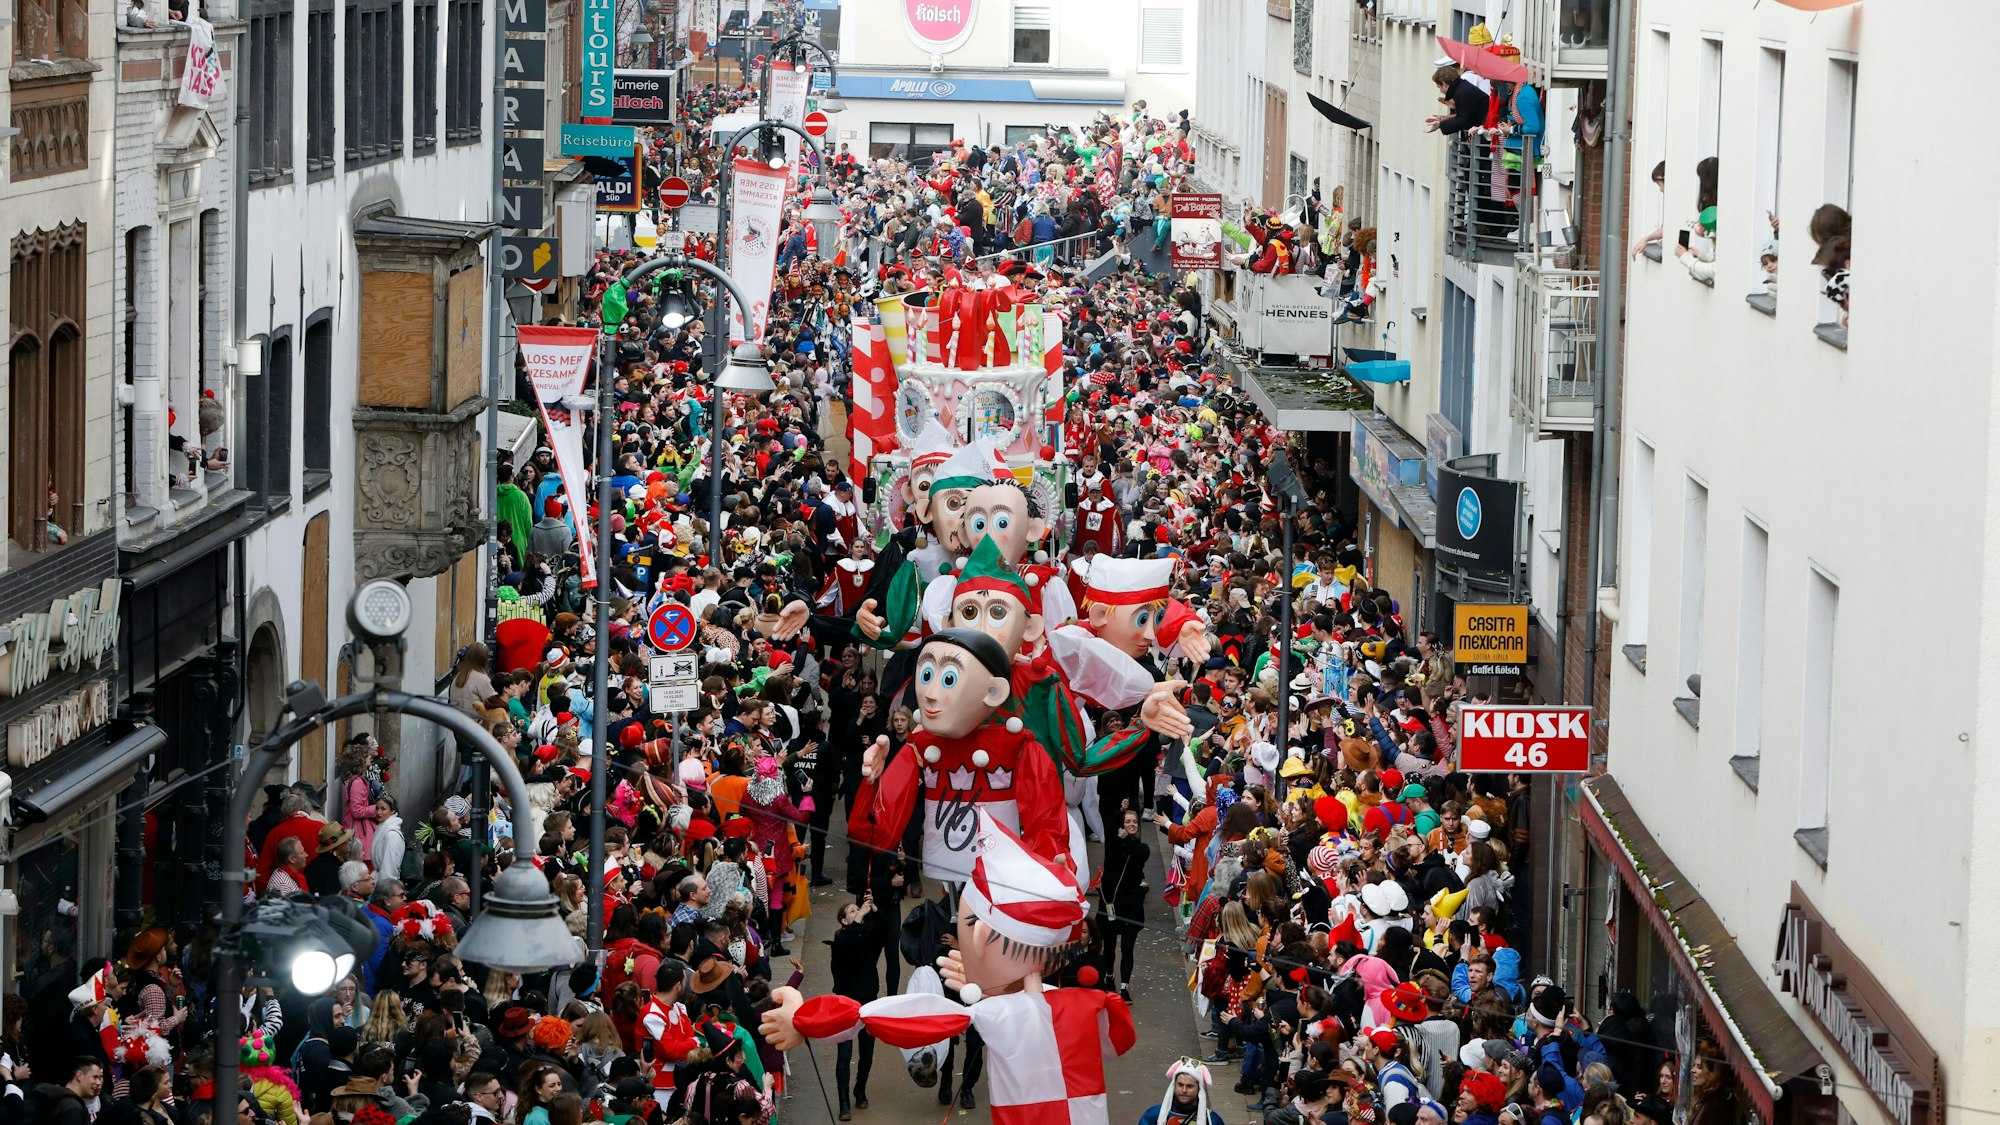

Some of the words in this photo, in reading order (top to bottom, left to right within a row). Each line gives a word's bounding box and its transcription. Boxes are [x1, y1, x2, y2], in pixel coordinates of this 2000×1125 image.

[915, 3, 961, 24] Kölsch
[890, 79, 929, 92] APOLLO
[502, 0, 528, 271] MARANO
[563, 133, 632, 148] Reisebüro
[595, 181, 632, 194] ALDI
[605, 193, 620, 202] SÜD
[1265, 309, 1328, 319] HENNES
[527, 353, 556, 365] LOSS
[1468, 616, 1515, 632] CASITA
[1459, 635, 1524, 651] MEXICANA
[1472, 664, 1495, 676] Gaffel
[1495, 665, 1520, 676] Kölsch
[1463, 711, 1588, 739] KIOSK
[1504, 742, 1549, 768] 46
[793, 761, 817, 770] SWAT
